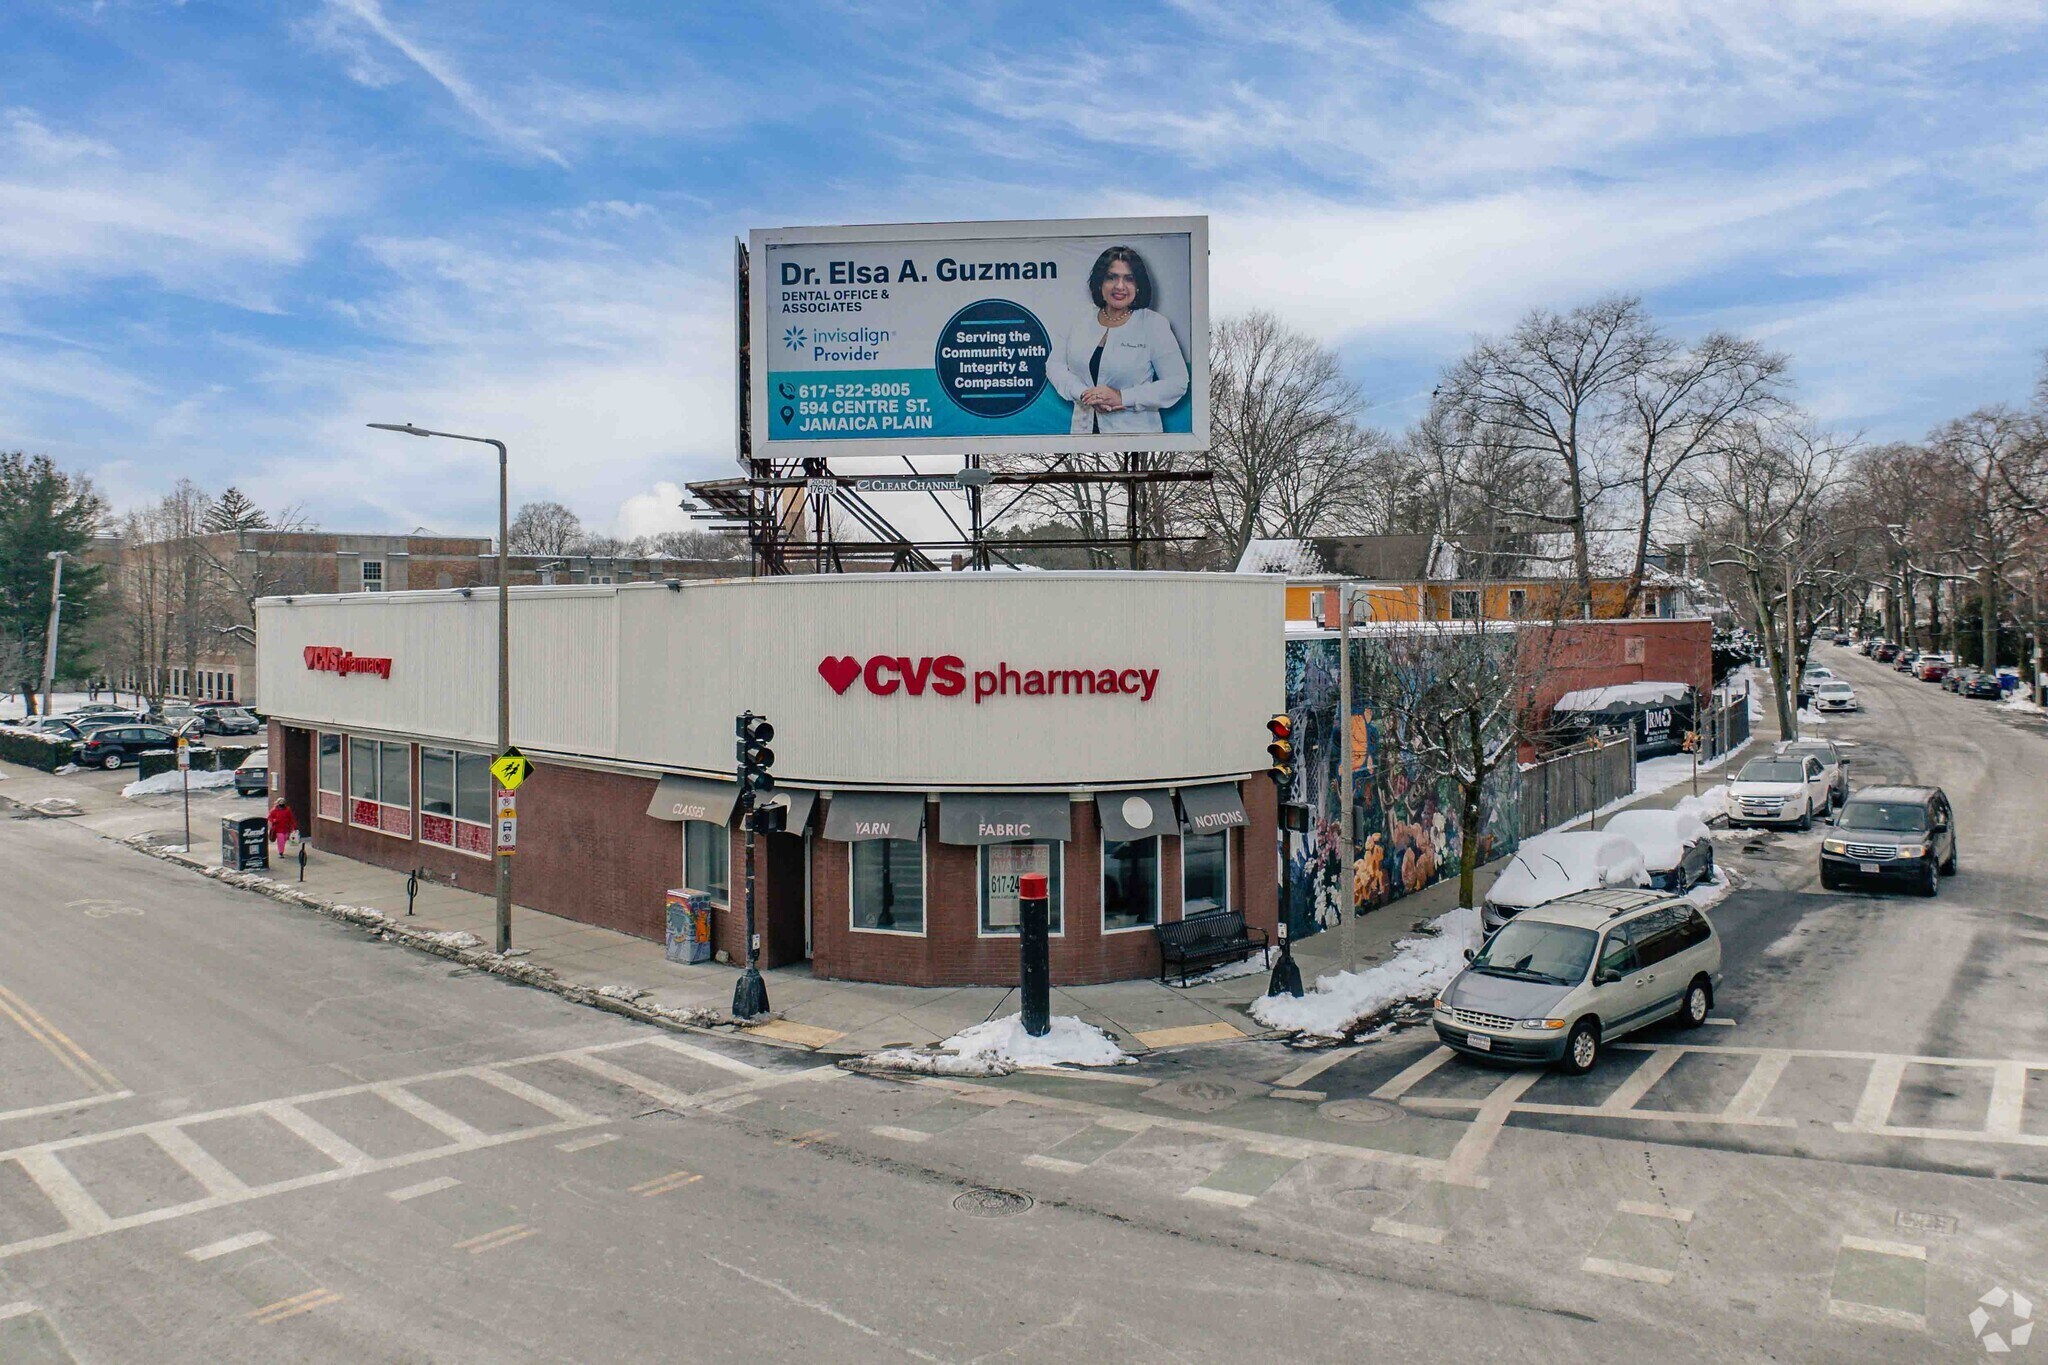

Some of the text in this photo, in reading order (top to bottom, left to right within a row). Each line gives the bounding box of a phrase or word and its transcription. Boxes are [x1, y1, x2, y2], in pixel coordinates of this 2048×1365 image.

[781, 257, 1058, 286] Dr. Elsa A. Guzman
[782, 289, 890, 302] DENTAL OFFICE &
[782, 302, 863, 313] ASSOCIATES
[813, 327, 890, 346] invisalign
[956, 330, 1031, 345] Serving the
[814, 346, 880, 362] Provider
[941, 345, 1046, 360] Community with
[959, 360, 1029, 375] Integrity &
[954, 375, 1034, 390] Compassion
[799, 383, 911, 399] 617-522-8005
[799, 399, 931, 415] 594 CENTRE ST.
[799, 415, 933, 432] JAMAICA PLAIN
[863, 655, 1160, 704] CVS pharmacy
[672, 803, 706, 818] CLASSES
[1194, 810, 1243, 828] NOTIONS
[855, 822, 891, 835] YARN
[978, 823, 1031, 836] FABRIC
[1021, 848, 1047, 858] SPACE
